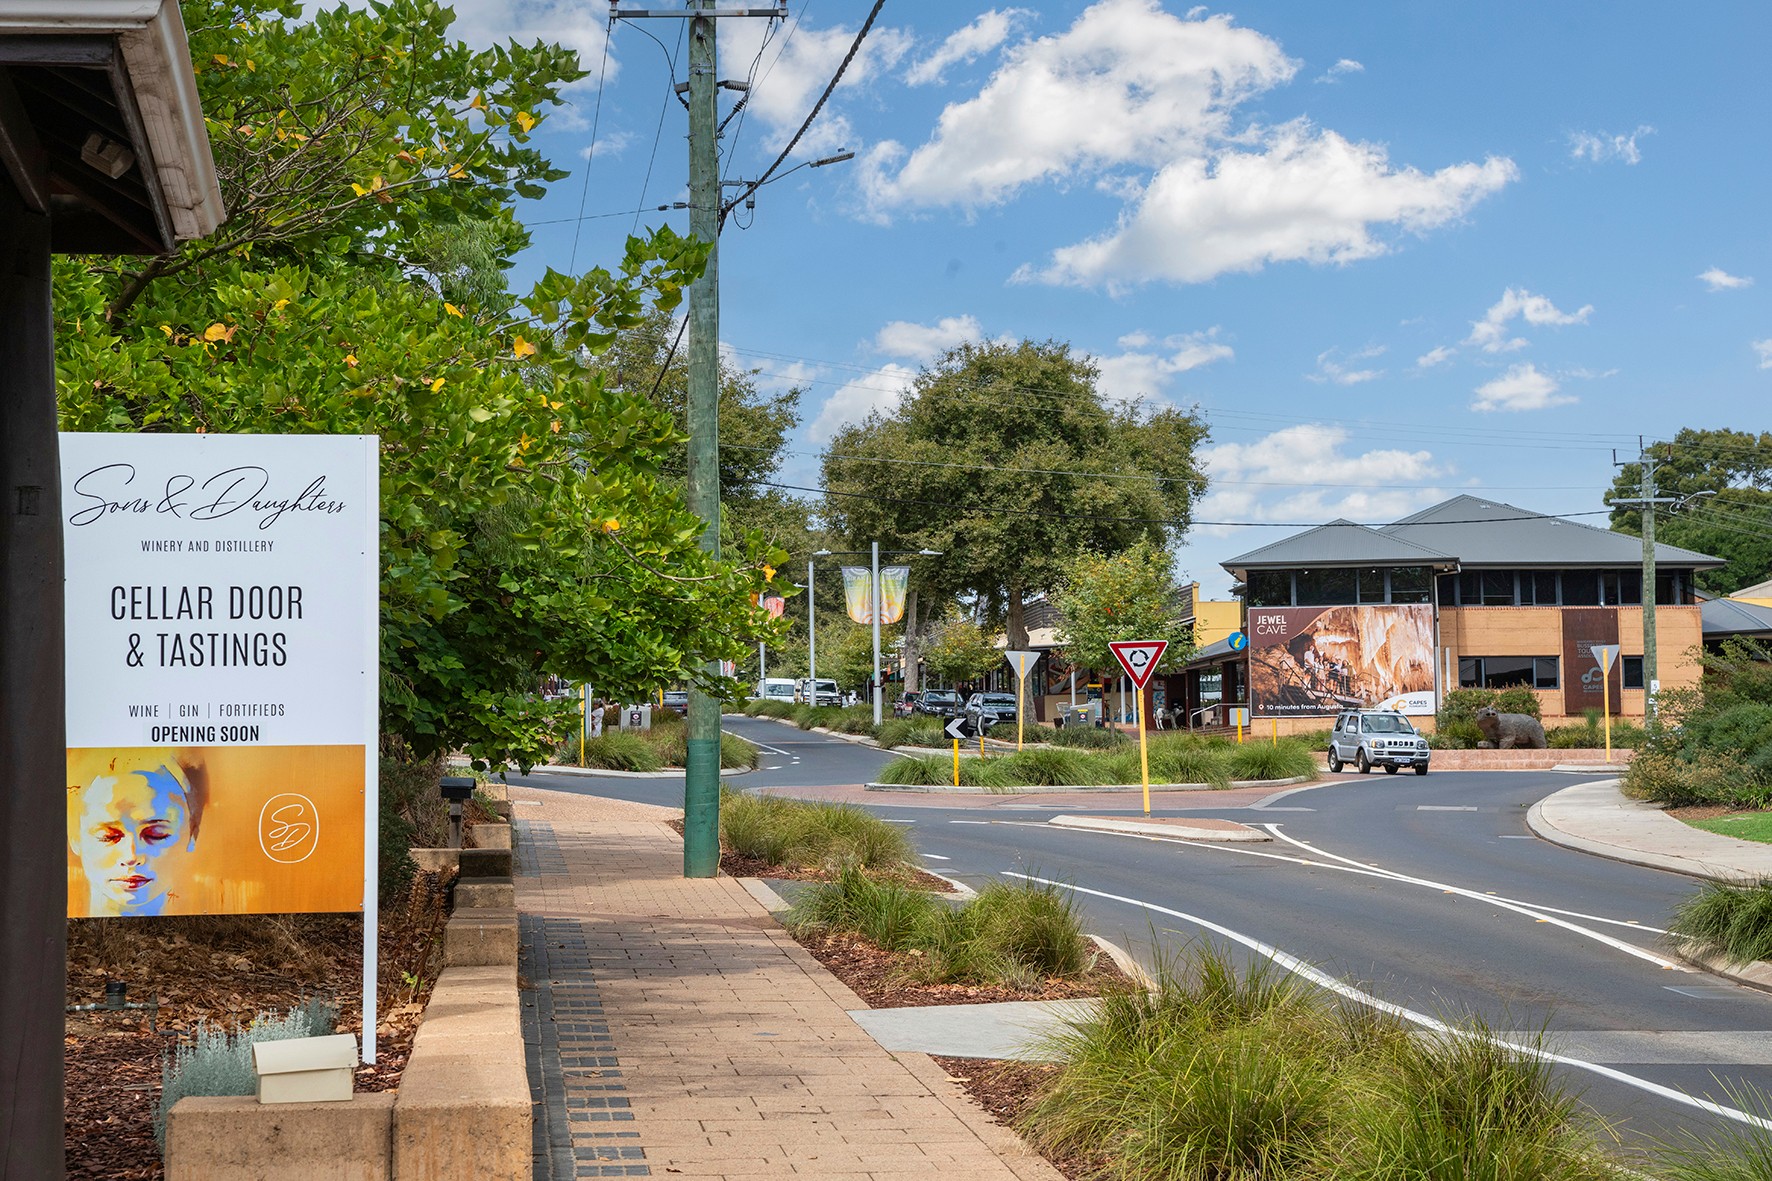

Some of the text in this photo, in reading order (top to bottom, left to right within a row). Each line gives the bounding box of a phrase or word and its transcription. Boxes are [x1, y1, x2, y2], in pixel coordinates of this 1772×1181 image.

[69, 463, 346, 531] Sons & Daughters
[141, 540, 274, 553] WINERY AND DISTILLERY
[111, 586, 303, 620] CELLAR DOOR
[1257, 615, 1287, 625] JEWEL
[1256, 625, 1287, 635] CAVE
[126, 632, 287, 668] & TASTINGS
[129, 703, 285, 718] WINE GIN FORTIFIEDS
[152, 725, 260, 743] OPENING SOON
